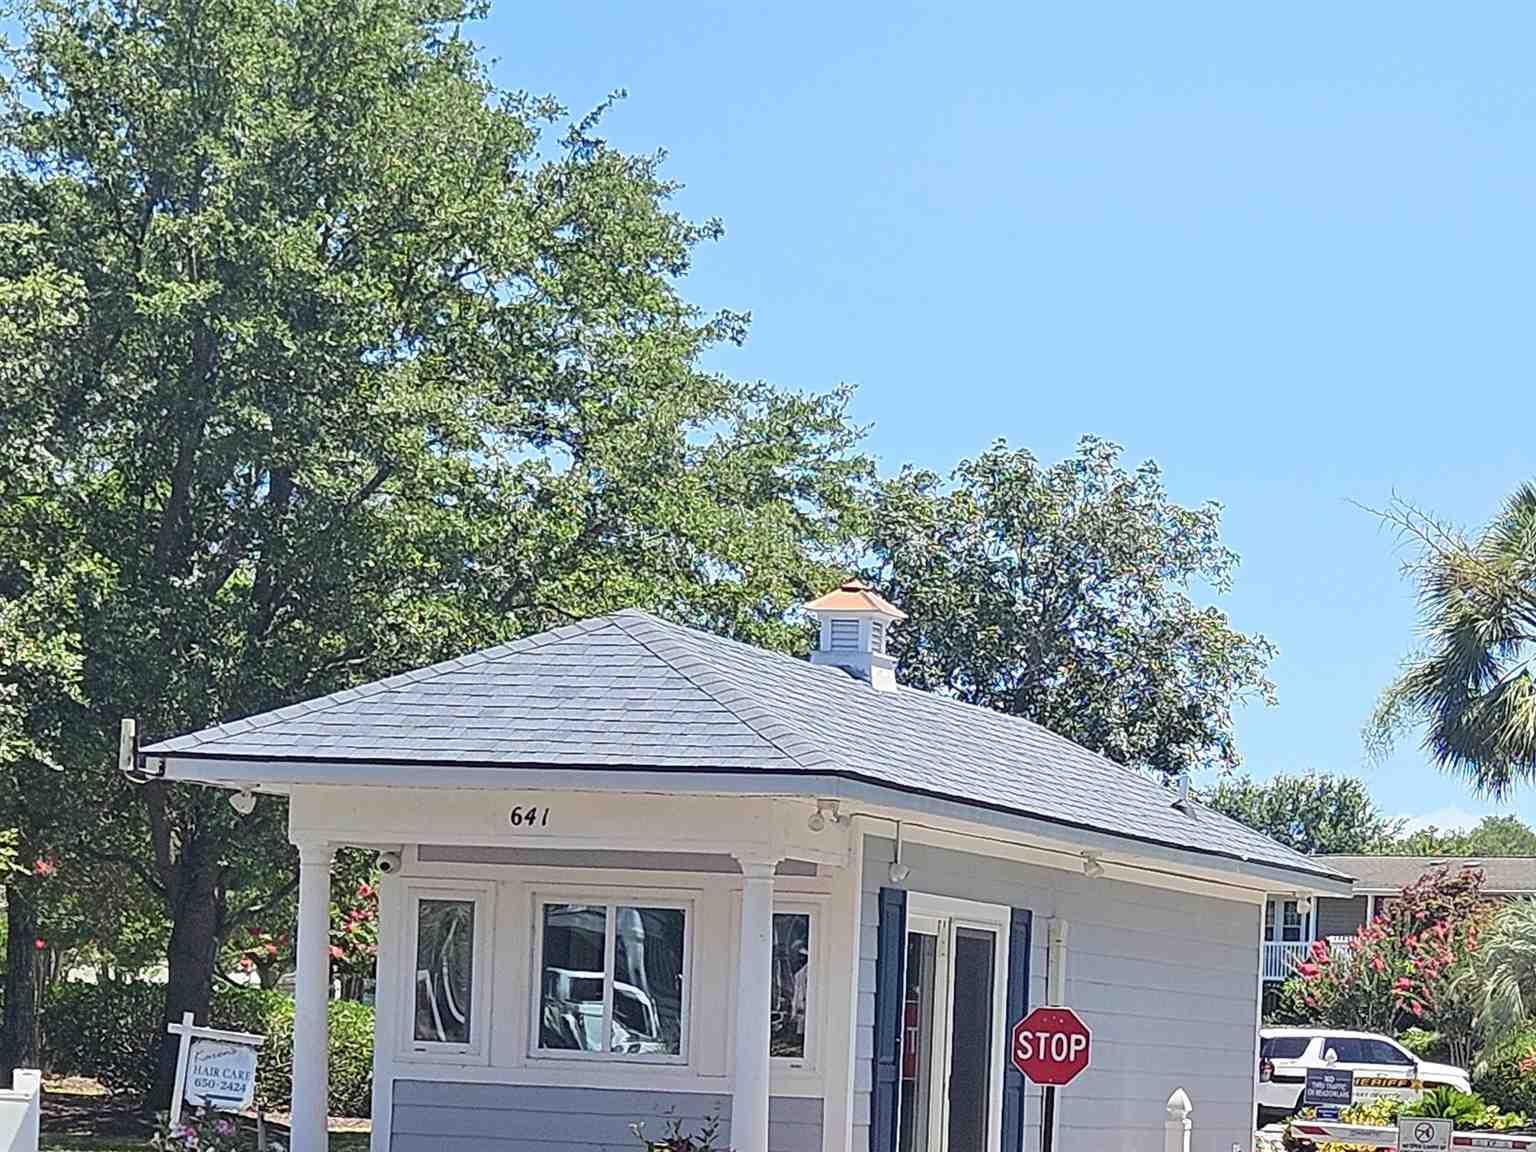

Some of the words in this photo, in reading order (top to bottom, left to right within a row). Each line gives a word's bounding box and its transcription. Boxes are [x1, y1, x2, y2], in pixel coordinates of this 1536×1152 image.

[511, 806, 549, 826] 641
[1017, 1031, 1086, 1061] STOP
[193, 1065, 220, 1078] HAIR
[222, 1067, 251, 1081] CARE
[194, 1078, 246, 1093] 650-2424
